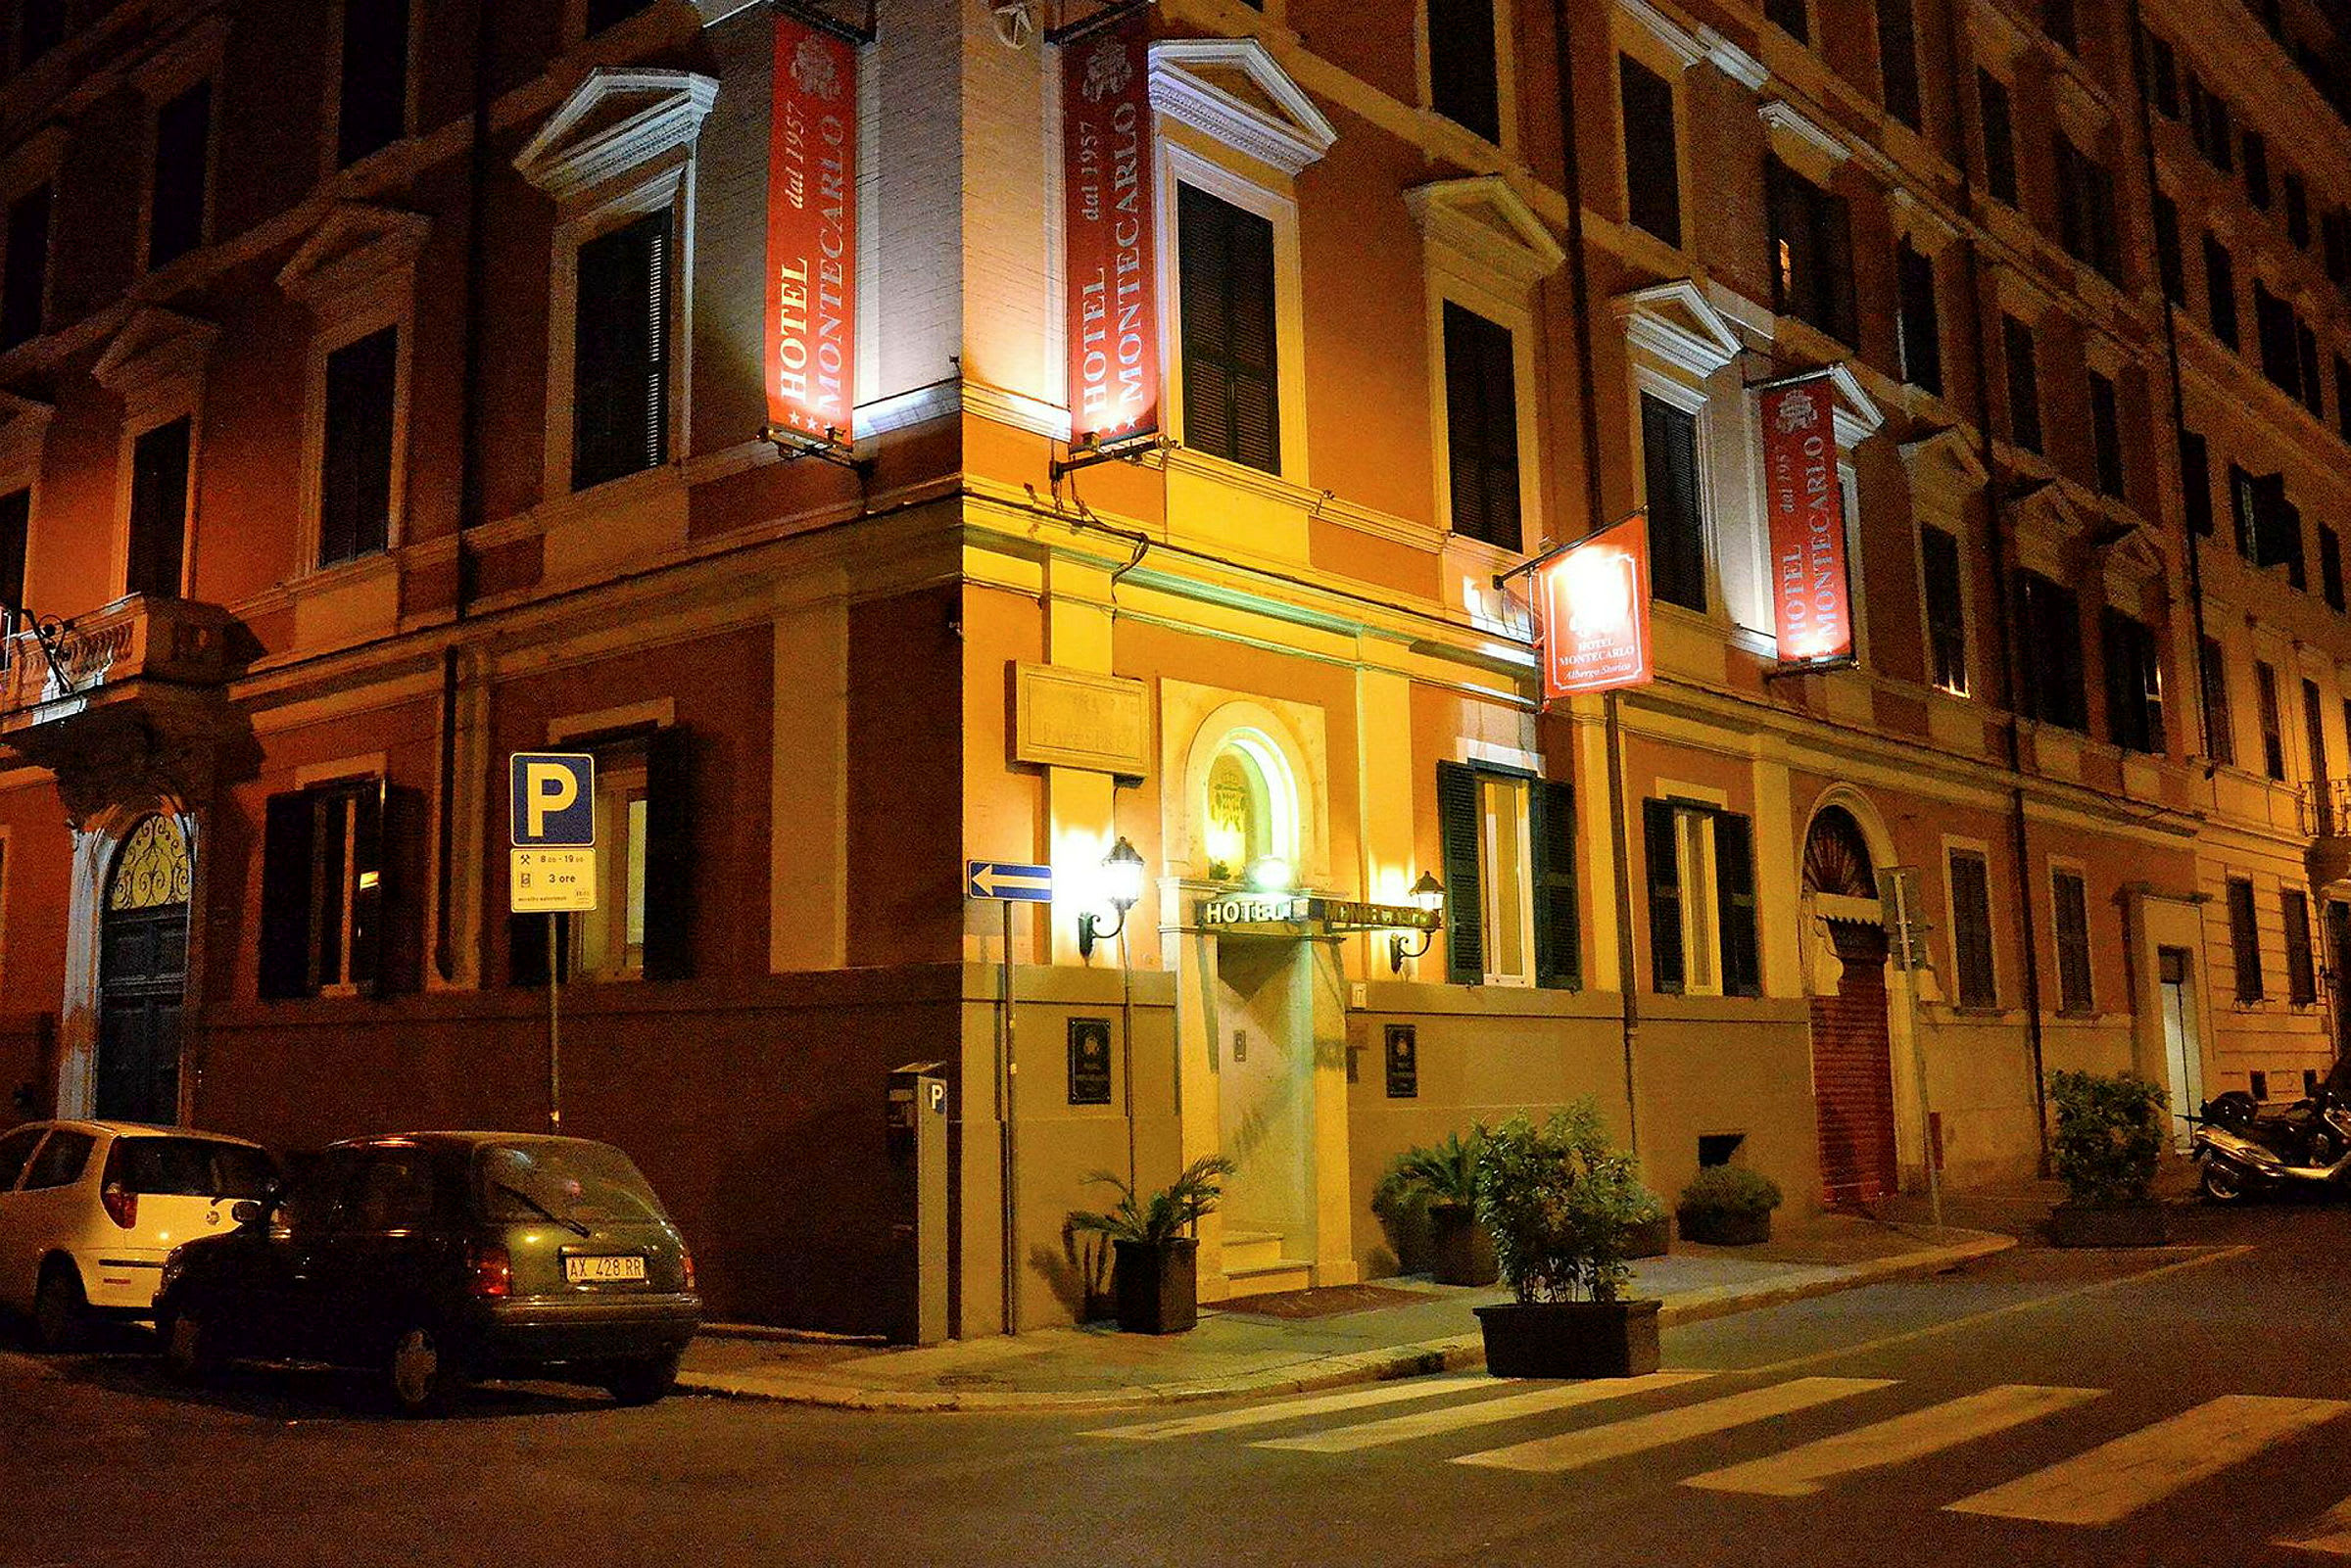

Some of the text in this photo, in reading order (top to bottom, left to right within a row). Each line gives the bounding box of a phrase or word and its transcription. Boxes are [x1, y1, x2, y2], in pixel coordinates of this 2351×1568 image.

[781, 101, 808, 404] HOTEL dal 1957
[819, 115, 843, 421] MONTECARLO
[1080, 120, 1107, 416] HOTEL dal 1957
[1114, 102, 1143, 406] MONTECARLO
[1803, 436, 1840, 639] MONTECARLO
[1783, 545, 1807, 642] HOTEL
[1559, 644, 1635, 666] MONTECARLO
[1578, 638, 1614, 651] HOTEL
[527, 762, 578, 837] P
[549, 874, 576, 883] 3 ore
[1206, 900, 1287, 924] HOTEL
[932, 1084, 944, 1110] P
[570, 1258, 641, 1276] AX 428 RR
